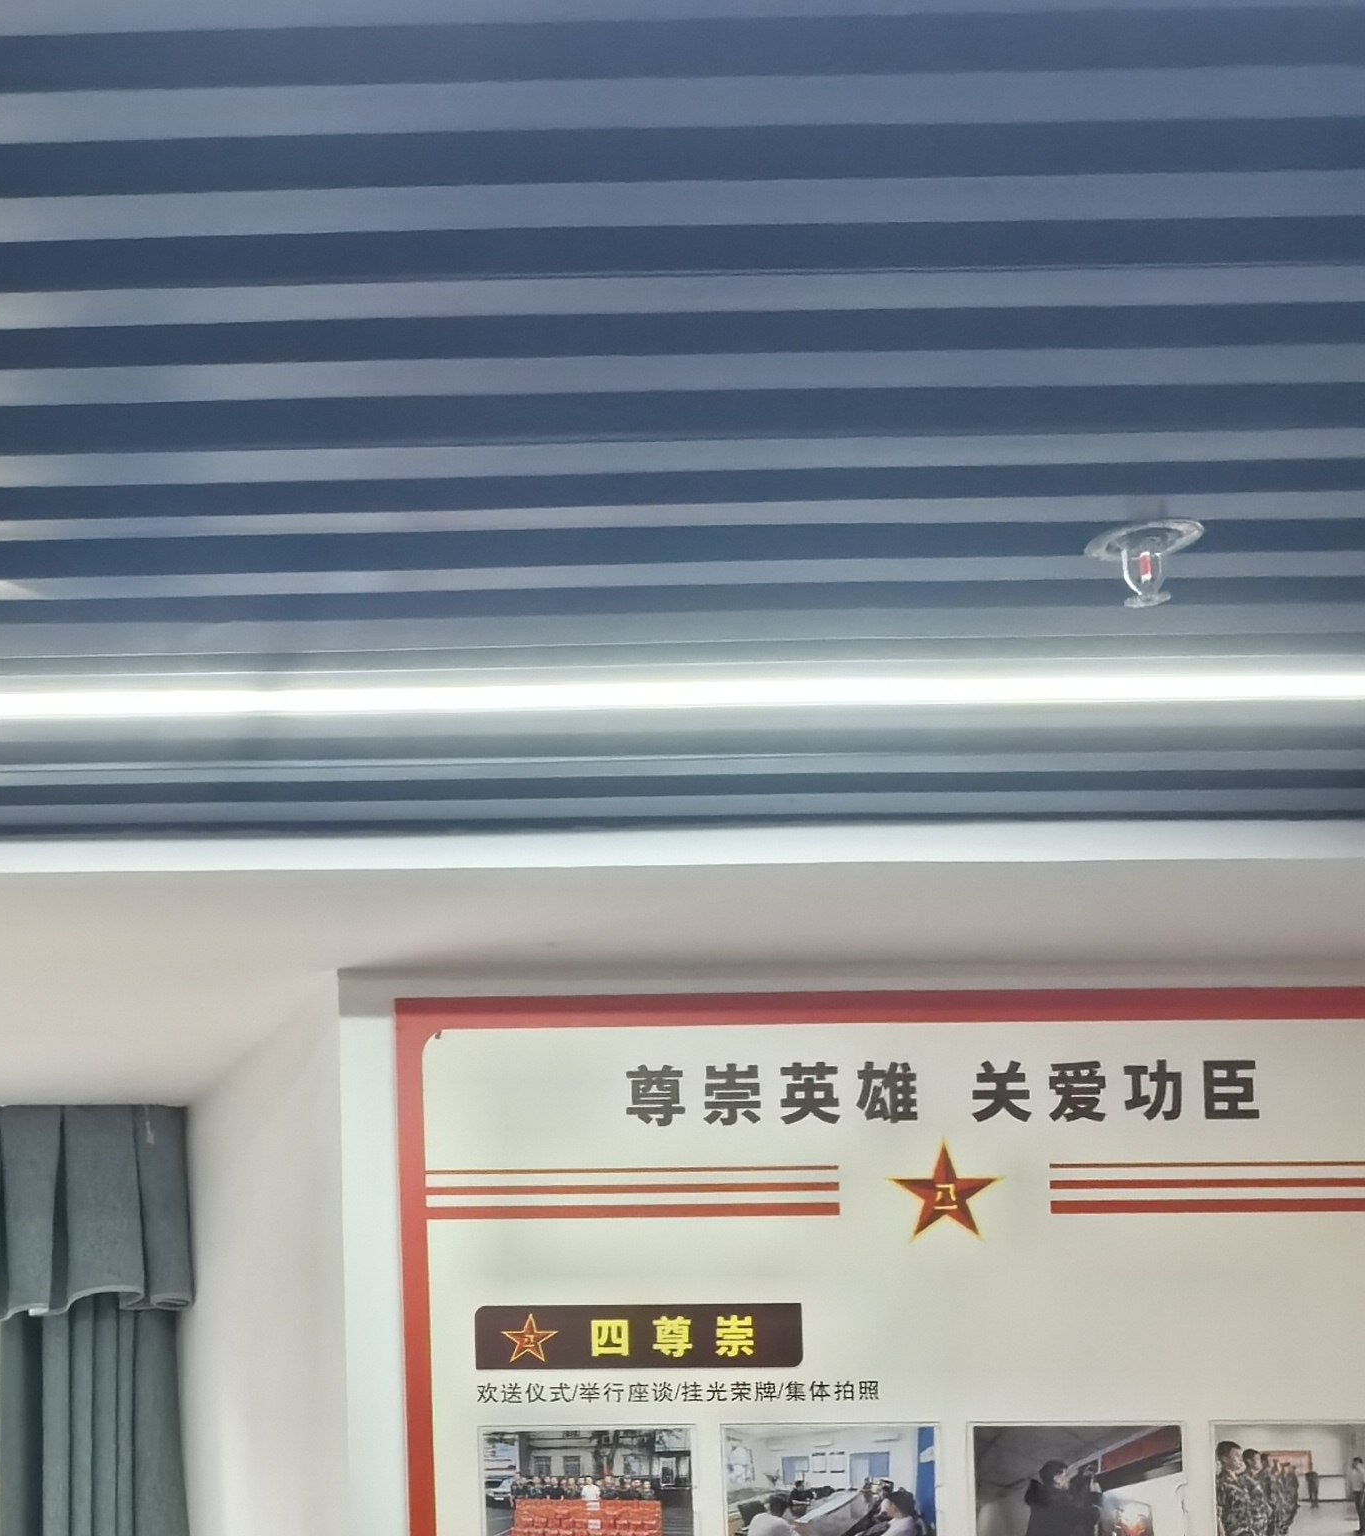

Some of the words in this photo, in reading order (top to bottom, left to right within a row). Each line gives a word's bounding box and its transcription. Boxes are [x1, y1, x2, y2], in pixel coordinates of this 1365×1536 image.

[626, 1061, 918, 1126] 尊崇英雄
[972, 1060, 1260, 1122] 关爱功臣
[591, 1315, 754, 1357] 四尊崇
[476, 1380, 880, 1404] 欢送仪式/举行座谈/挂光荣牌/集体拍照
